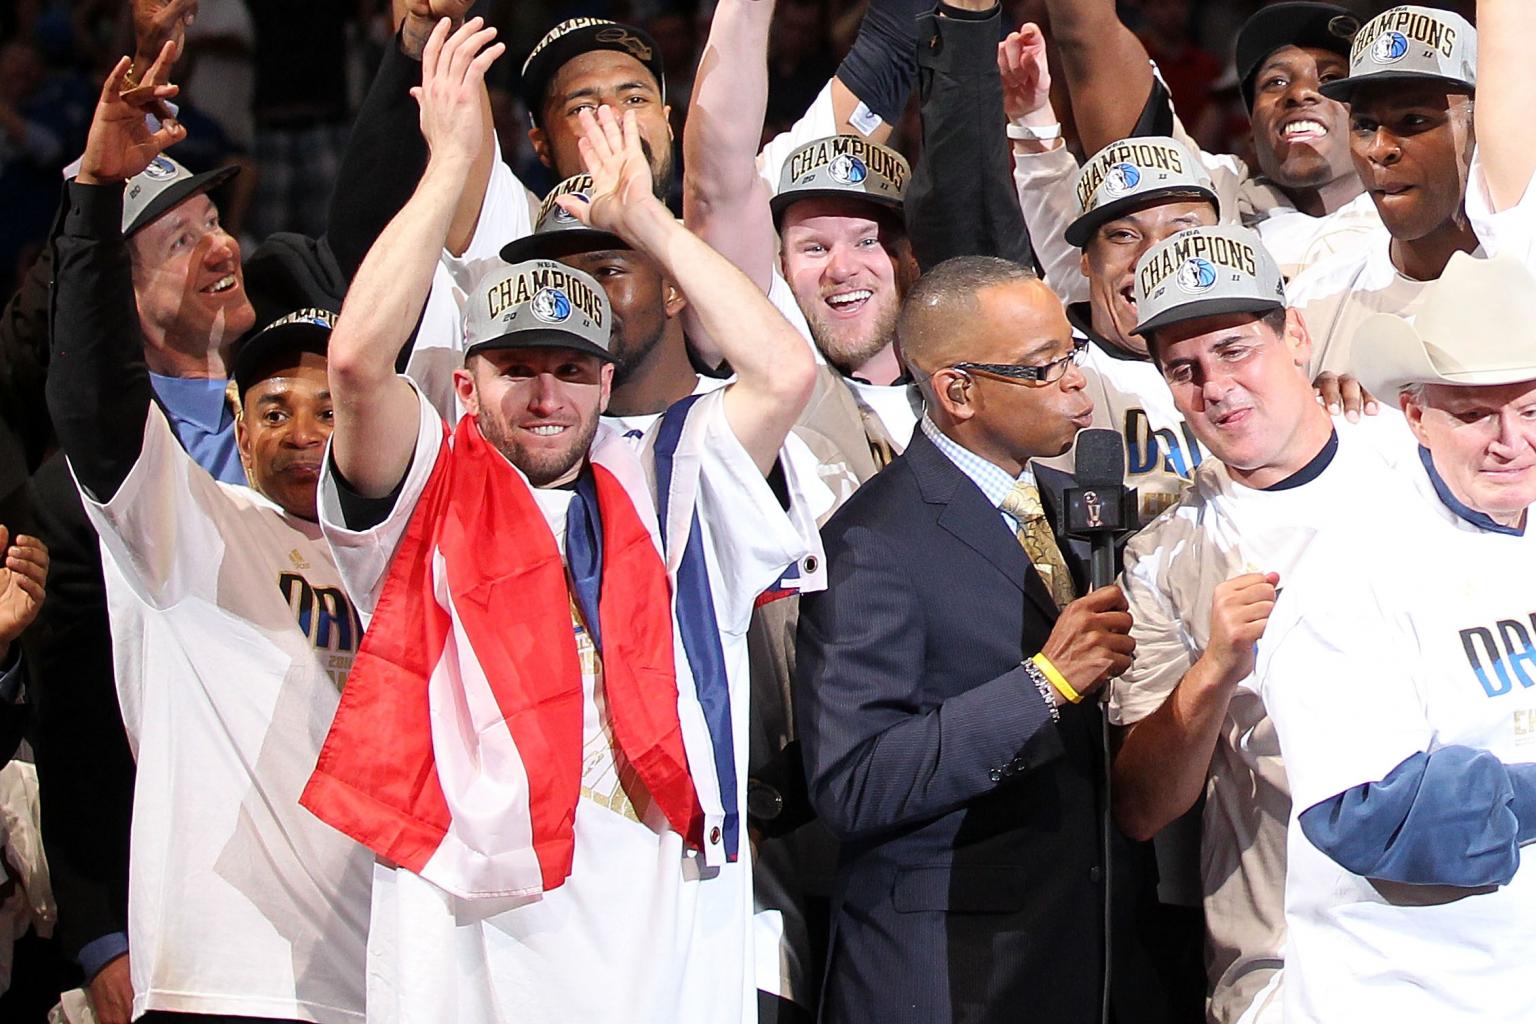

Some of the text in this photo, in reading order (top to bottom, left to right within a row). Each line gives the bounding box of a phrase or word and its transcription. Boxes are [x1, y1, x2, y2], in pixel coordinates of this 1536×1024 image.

[1422, 50, 1433, 59] 11
[791, 138, 905, 194] CHAMPIONS
[802, 174, 889, 191] 20 11
[1076, 144, 1183, 213] CHAMPIONS
[1158, 172, 1168, 180] 11
[1179, 229, 1200, 239] NBA
[1140, 235, 1256, 300] CHAMPIONS
[1231, 274, 1241, 282] 11
[487, 269, 603, 329] CHAMPIONS
[502, 311, 518, 323] 20
